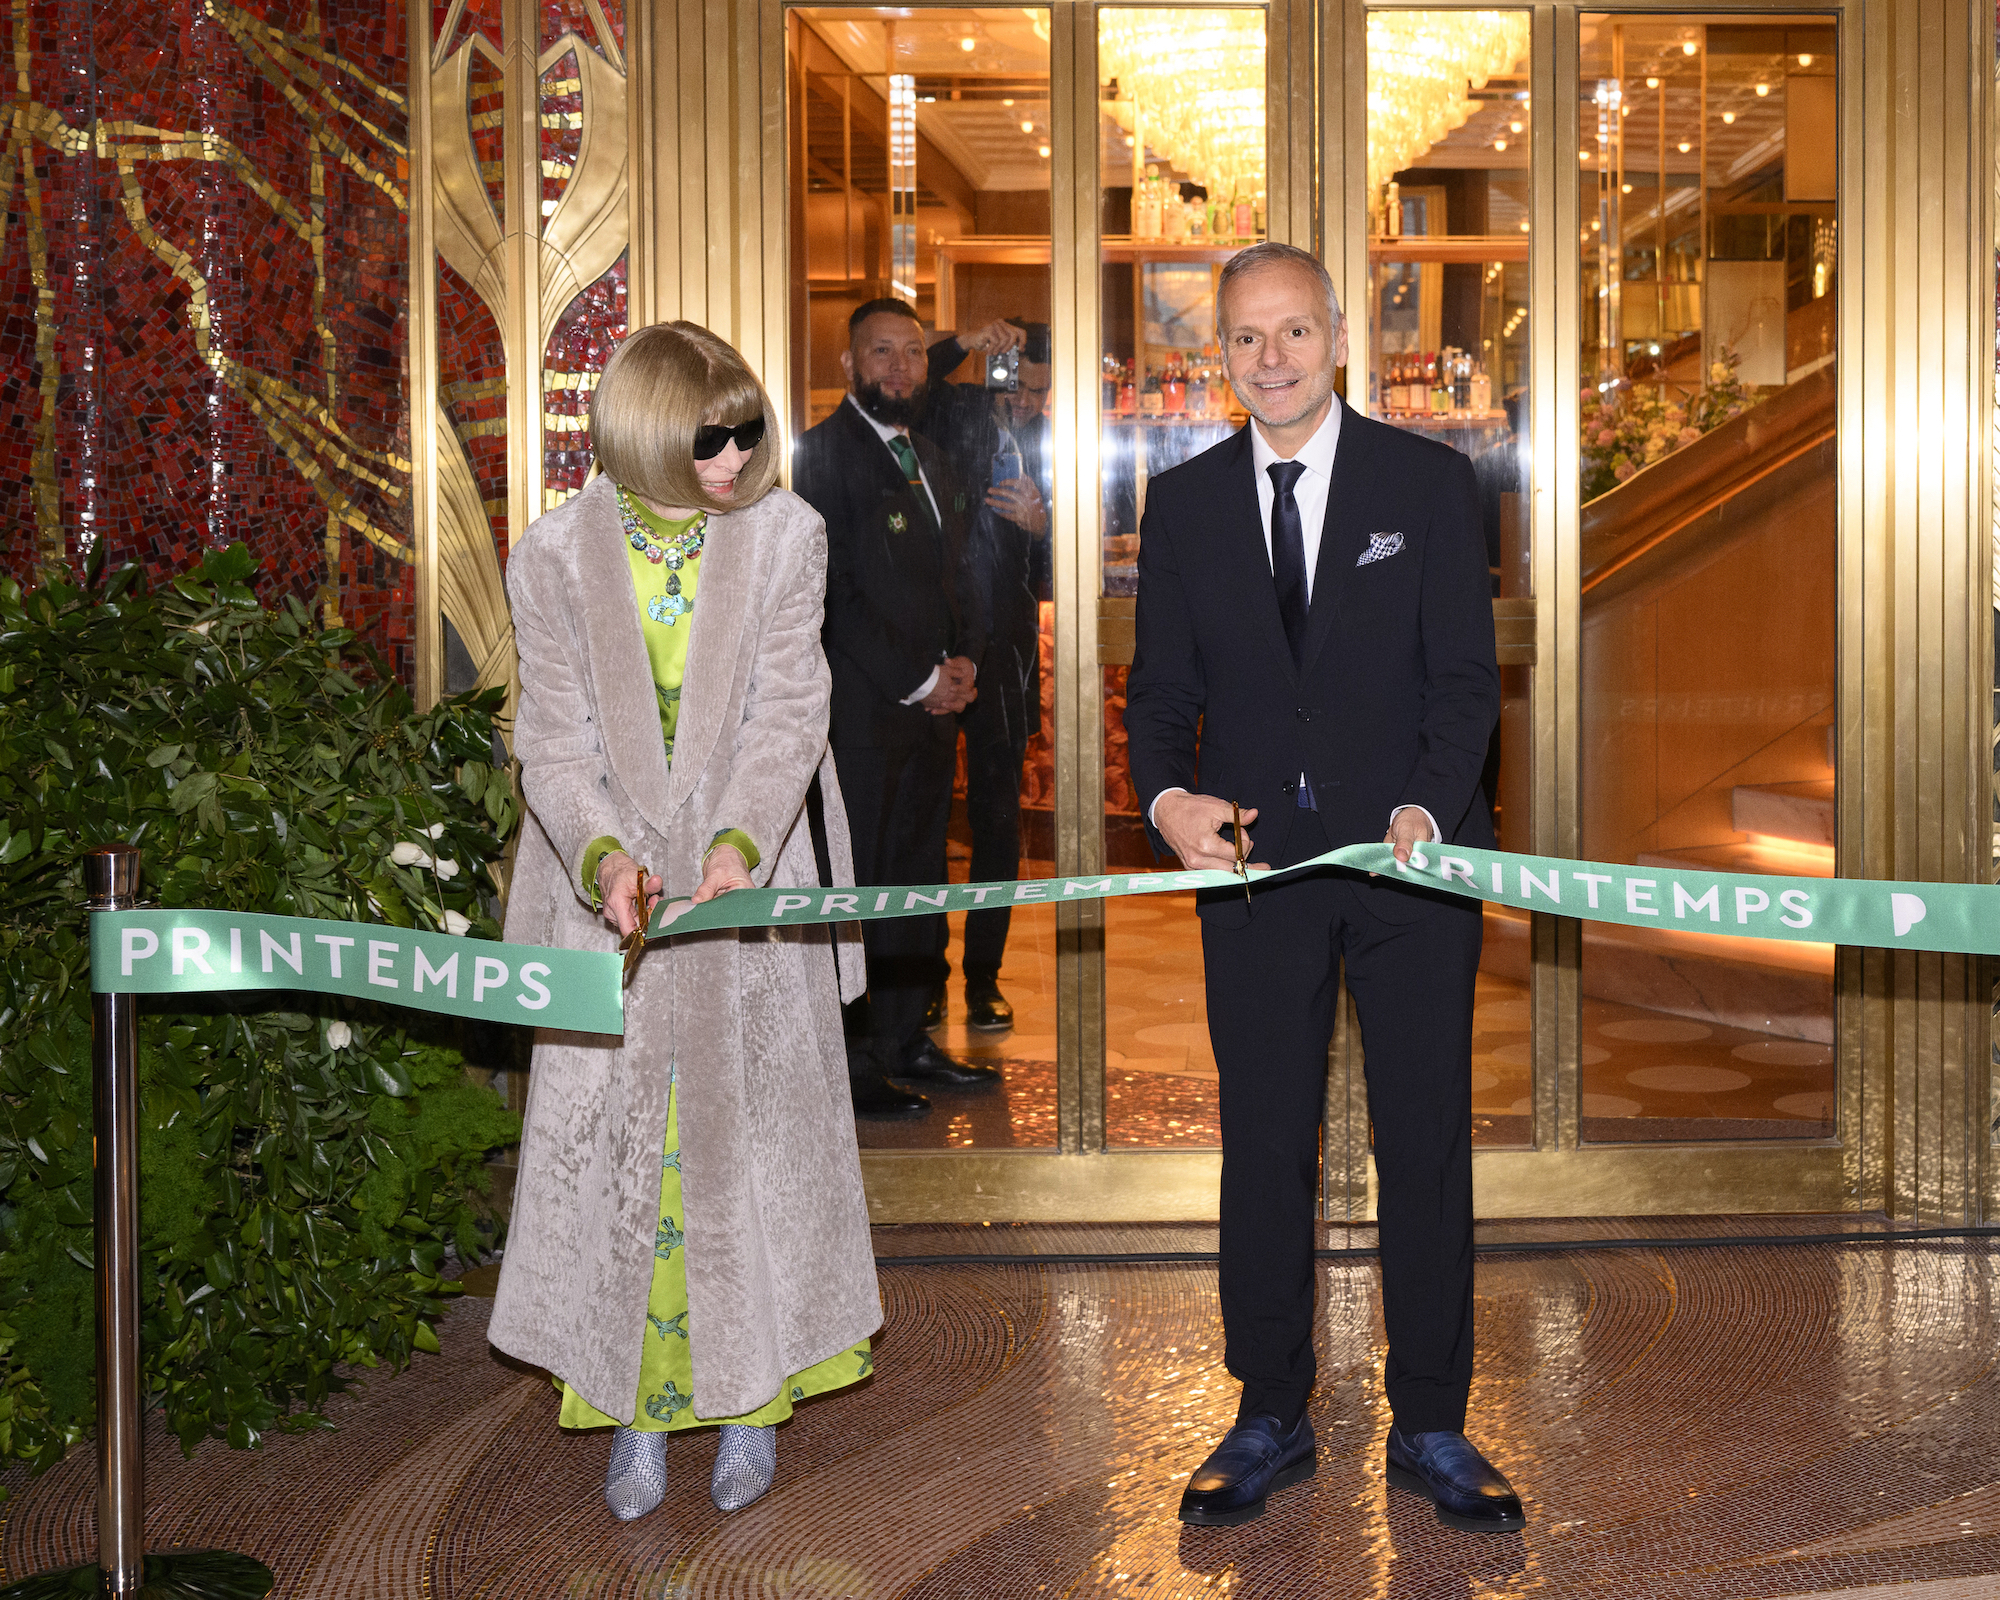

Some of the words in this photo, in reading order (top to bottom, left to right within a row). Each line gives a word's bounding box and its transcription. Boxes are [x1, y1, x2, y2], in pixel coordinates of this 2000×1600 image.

[771, 873, 1207, 918] PRINTEMPS
[1395, 850, 1814, 929] PRINTEMPS
[120, 926, 552, 1011] PRINTEMPS
